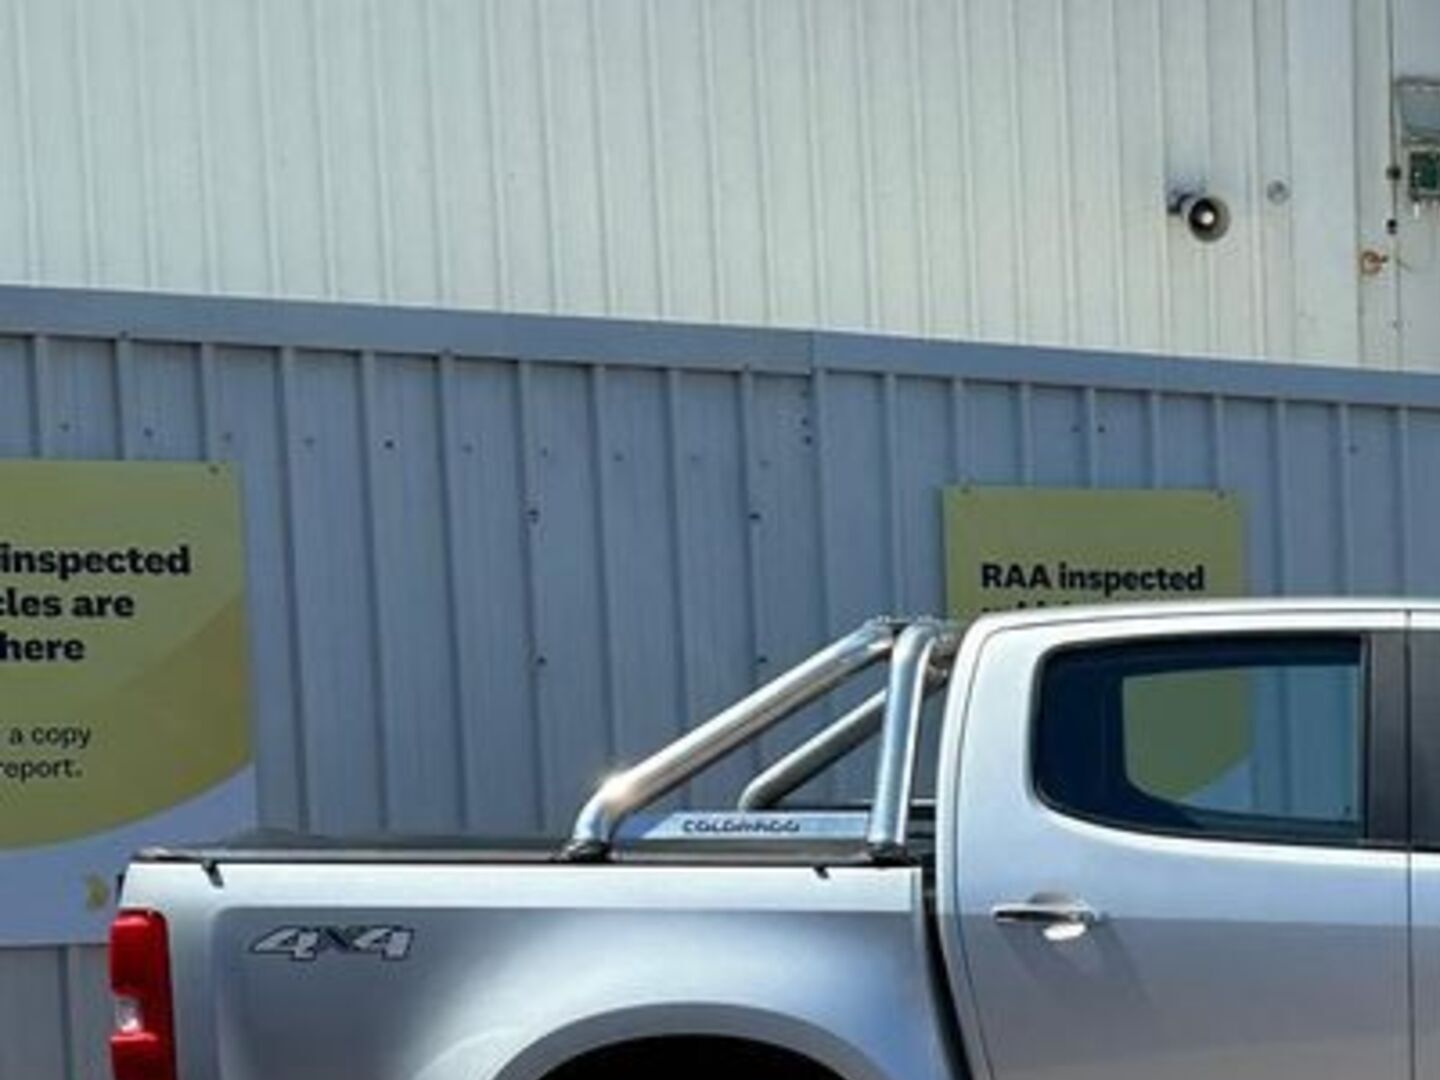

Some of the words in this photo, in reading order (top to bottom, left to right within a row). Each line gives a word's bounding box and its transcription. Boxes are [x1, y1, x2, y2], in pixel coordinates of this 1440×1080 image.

[0, 542, 190, 579] inspected
[981, 564, 1050, 589] RAA
[1058, 562, 1205, 597] inspected
[0, 587, 62, 617] les
[72, 596, 134, 617] are
[0, 630, 84, 660] here
[9, 727, 23, 746] a
[31, 727, 91, 750] copy
[0, 758, 83, 782] eport.
